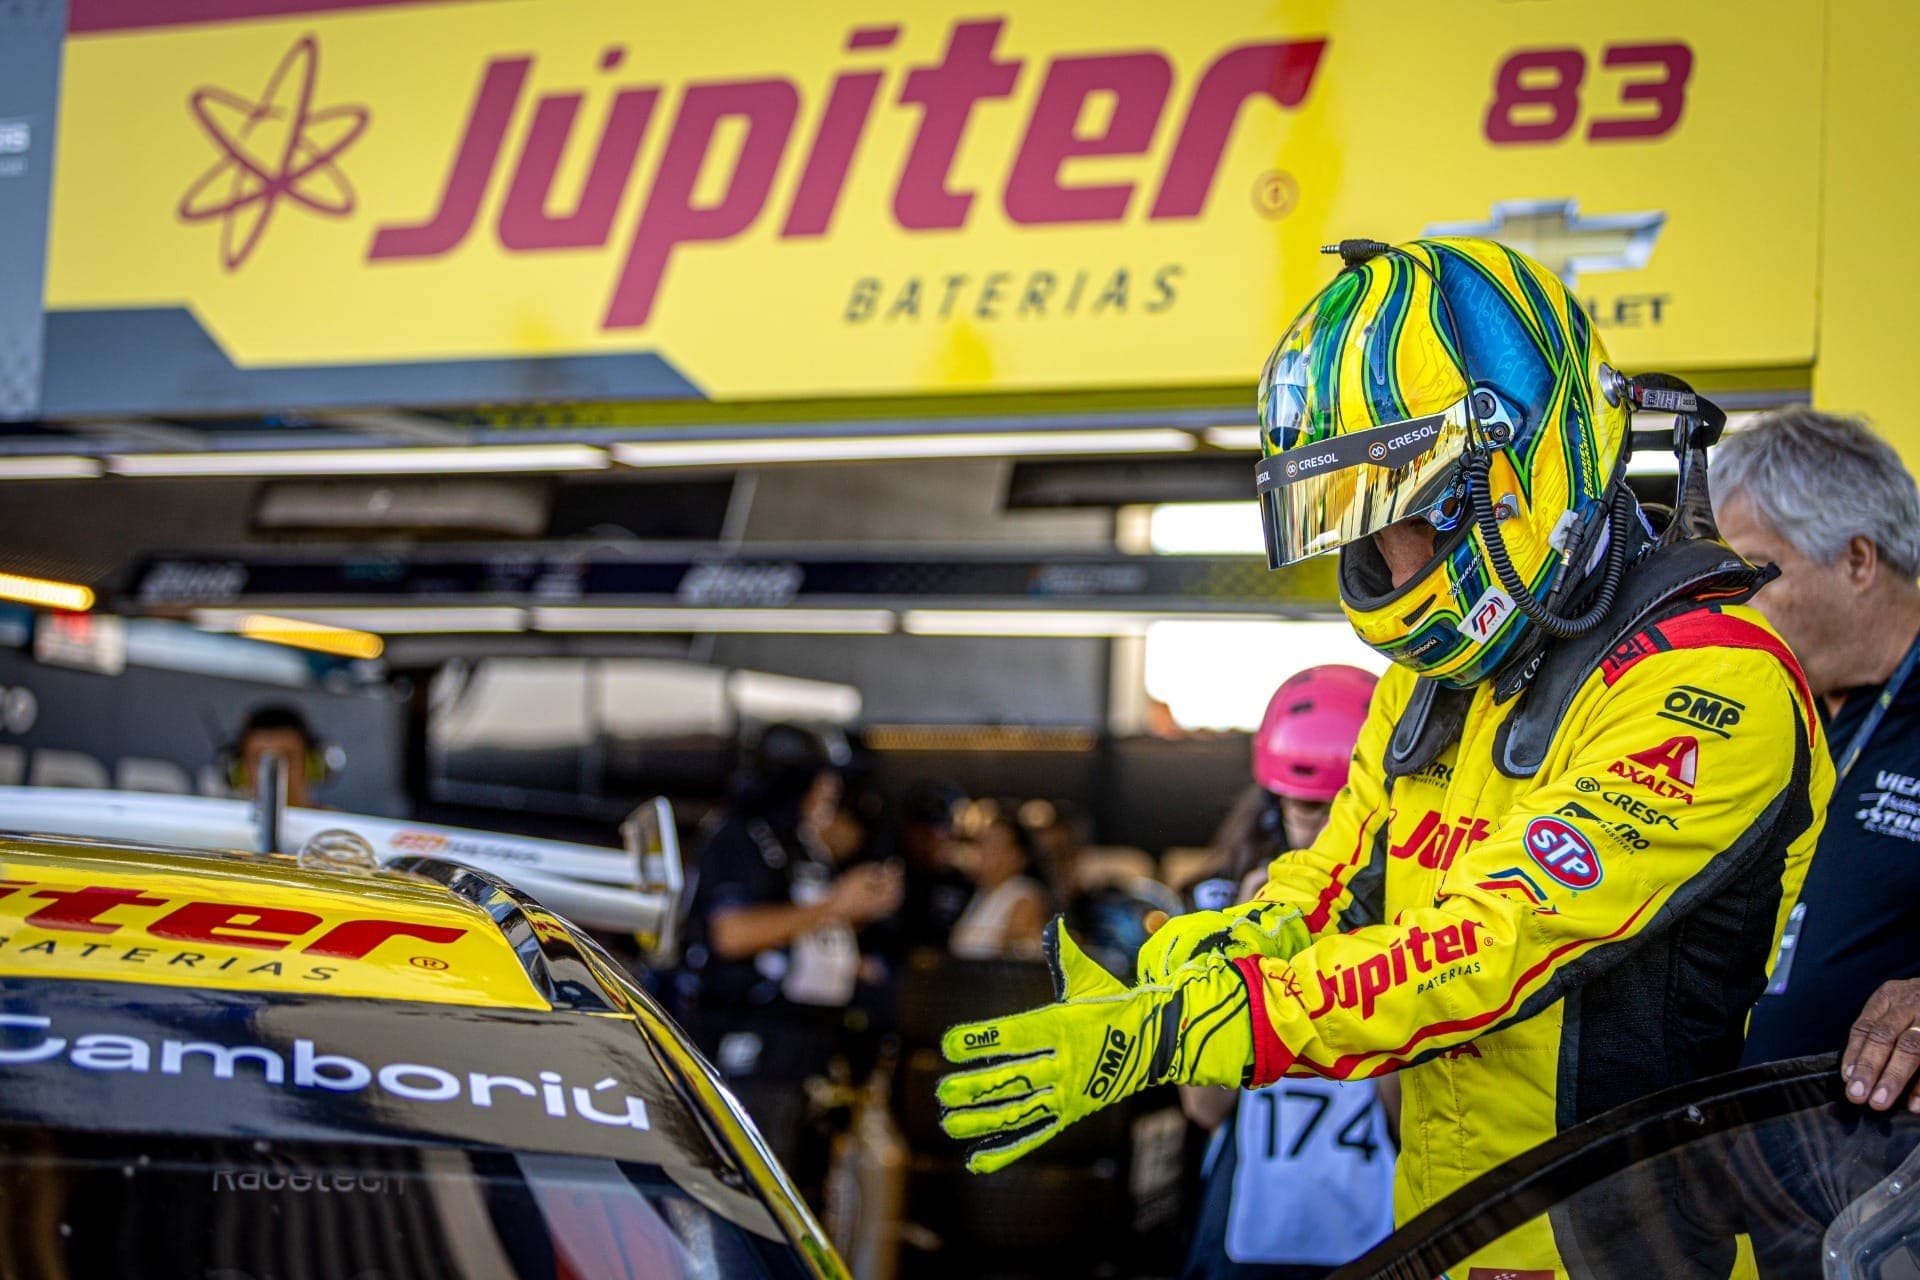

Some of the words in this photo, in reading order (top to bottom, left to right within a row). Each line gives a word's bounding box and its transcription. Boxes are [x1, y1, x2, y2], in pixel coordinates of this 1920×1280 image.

[1483, 42, 1693, 145] 83
[843, 265, 1184, 325] BATERIAS
[1387, 425, 1438, 450] CRESOL
[1298, 453, 1339, 471] CRESOL
[1664, 691, 1741, 729] OMP
[1606, 760, 1694, 806] AXALTA
[1532, 828, 1592, 878] STP
[1309, 918, 1486, 1021] Júpiter
[1417, 961, 1481, 995] BATERIAS
[963, 1029, 999, 1047] OMP
[1089, 1029, 1127, 1100] OMP
[1260, 1091, 1379, 1162] 174
